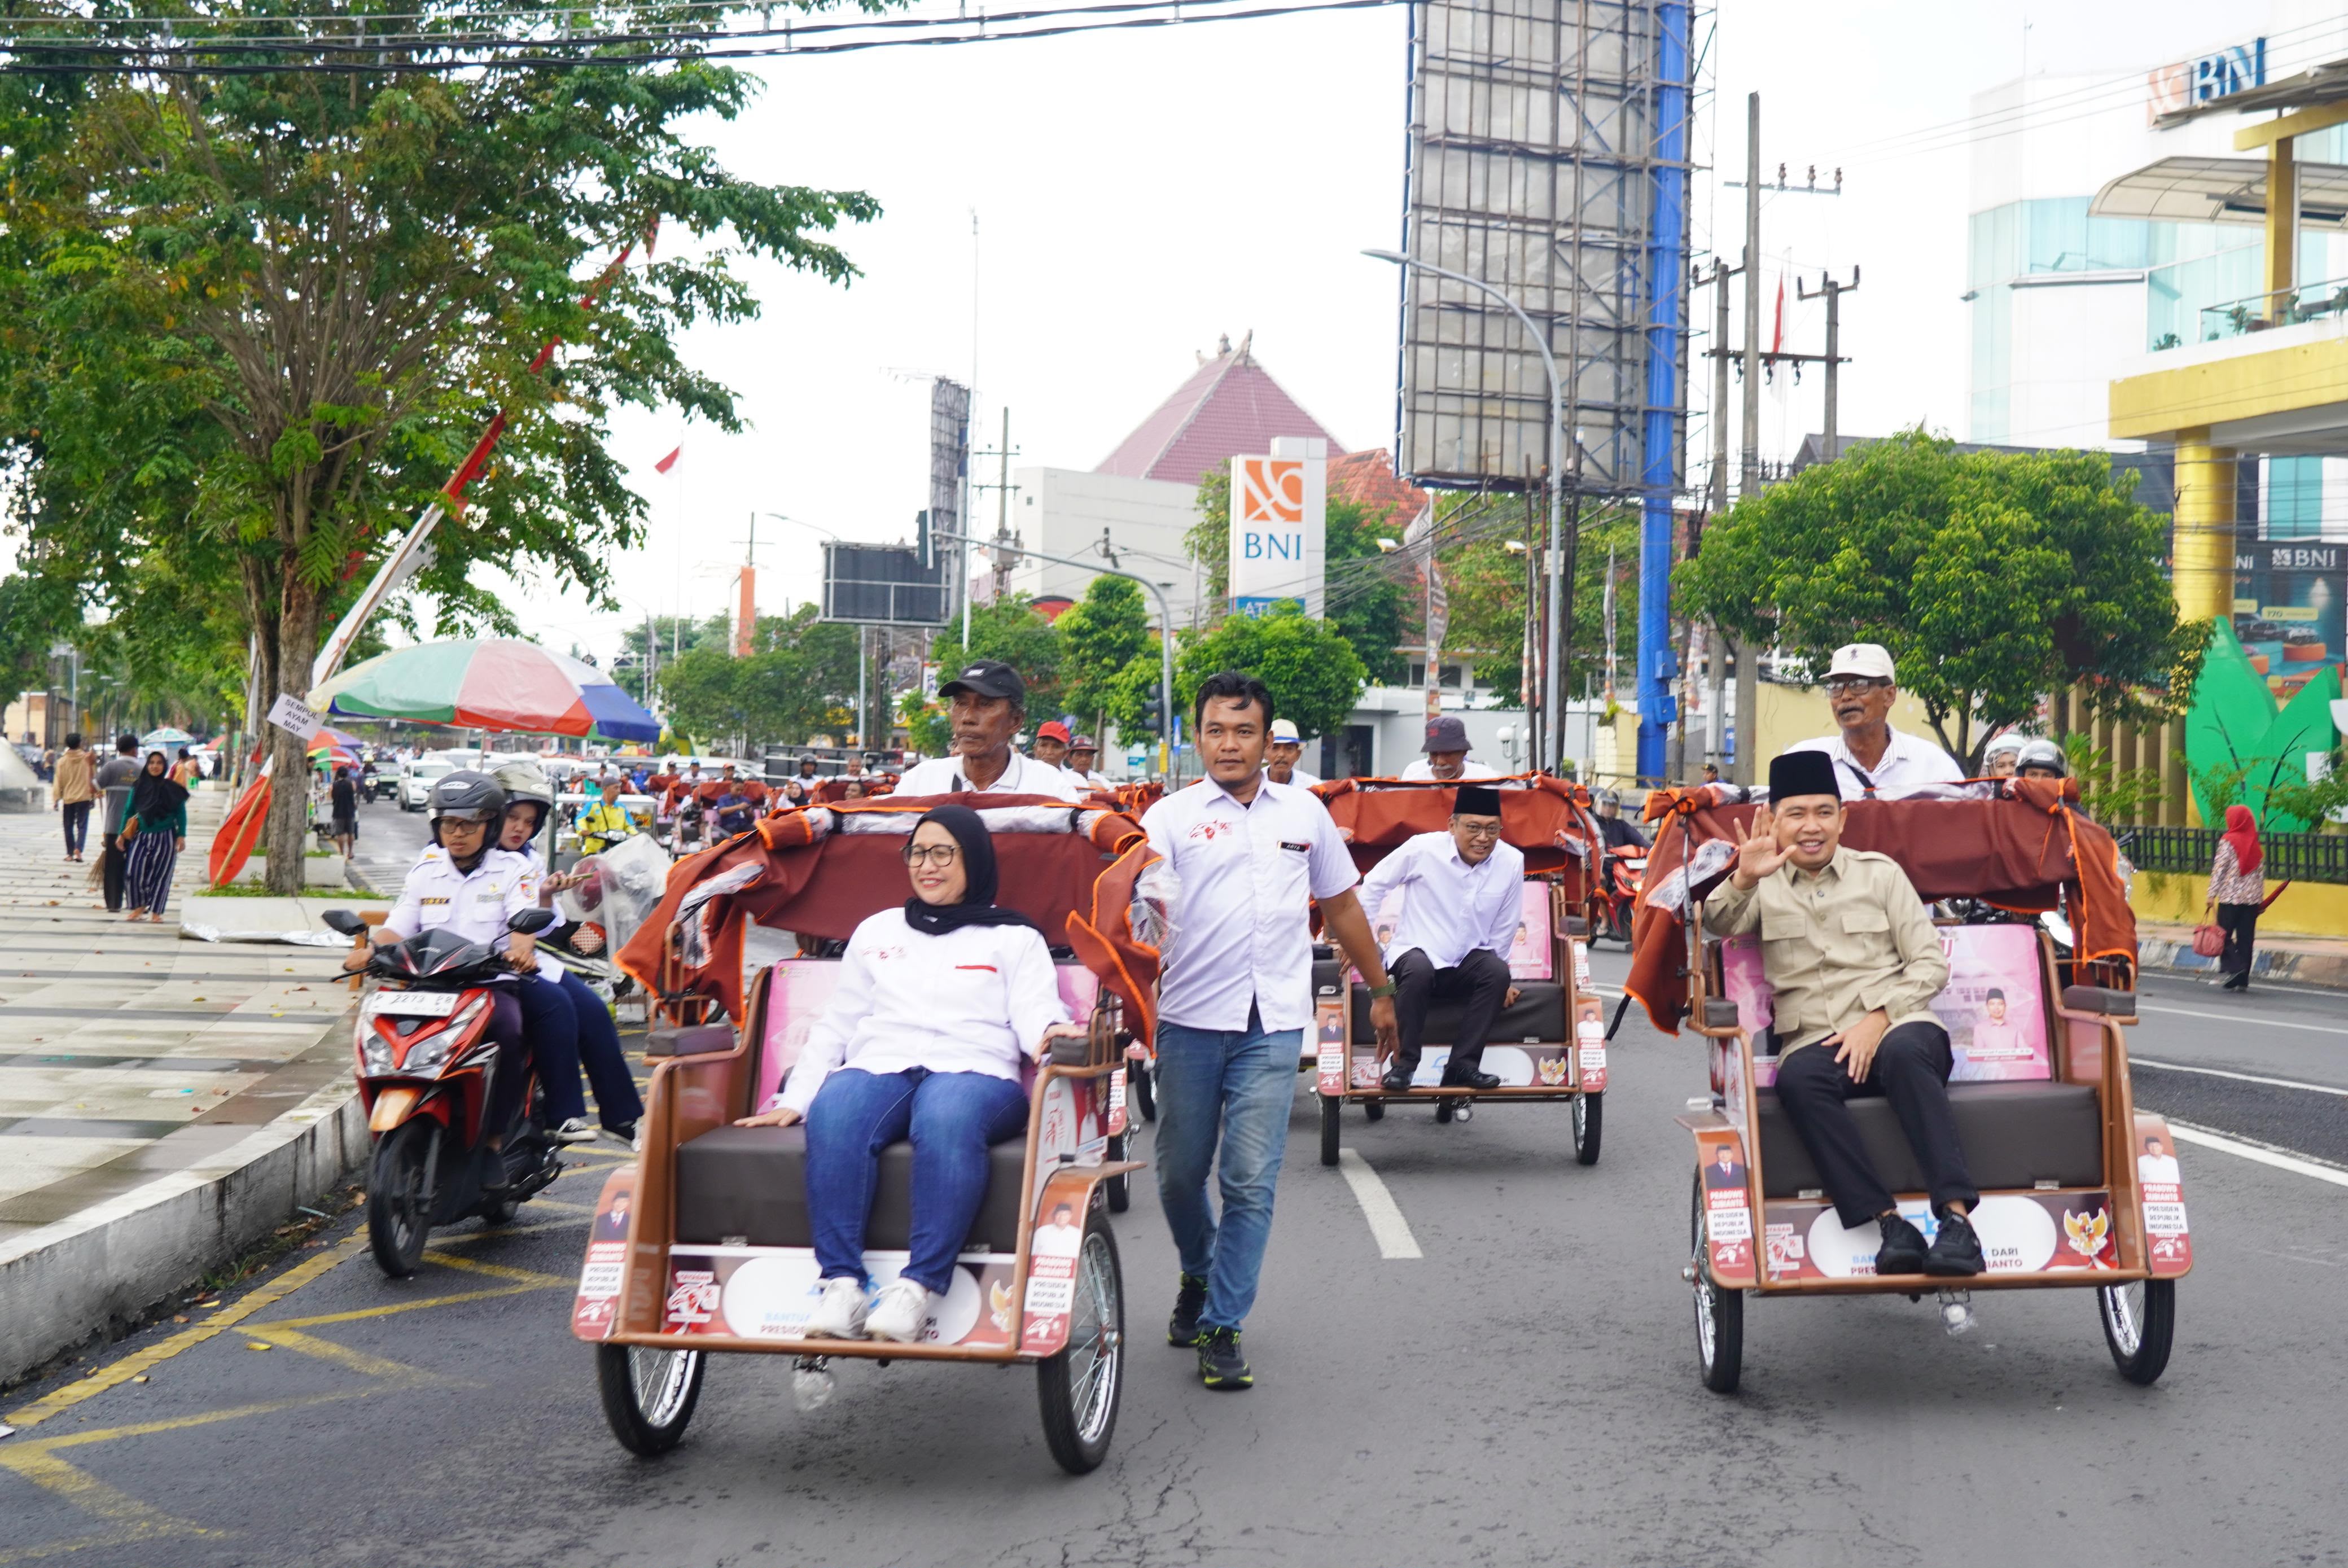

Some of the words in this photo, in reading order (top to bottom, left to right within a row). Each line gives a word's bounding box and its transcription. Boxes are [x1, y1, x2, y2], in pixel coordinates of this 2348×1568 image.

[2193, 37, 2266, 104] BNI
[1245, 532, 1302, 560] BNI
[2236, 555, 2254, 570] NI
[2295, 549, 2336, 567] BNI
[285, 711, 309, 726] AYAM
[283, 720, 302, 733] MAY
[2145, 1193, 2178, 1202] SUBIANTO
[1991, 1247, 2018, 1257] DARI
